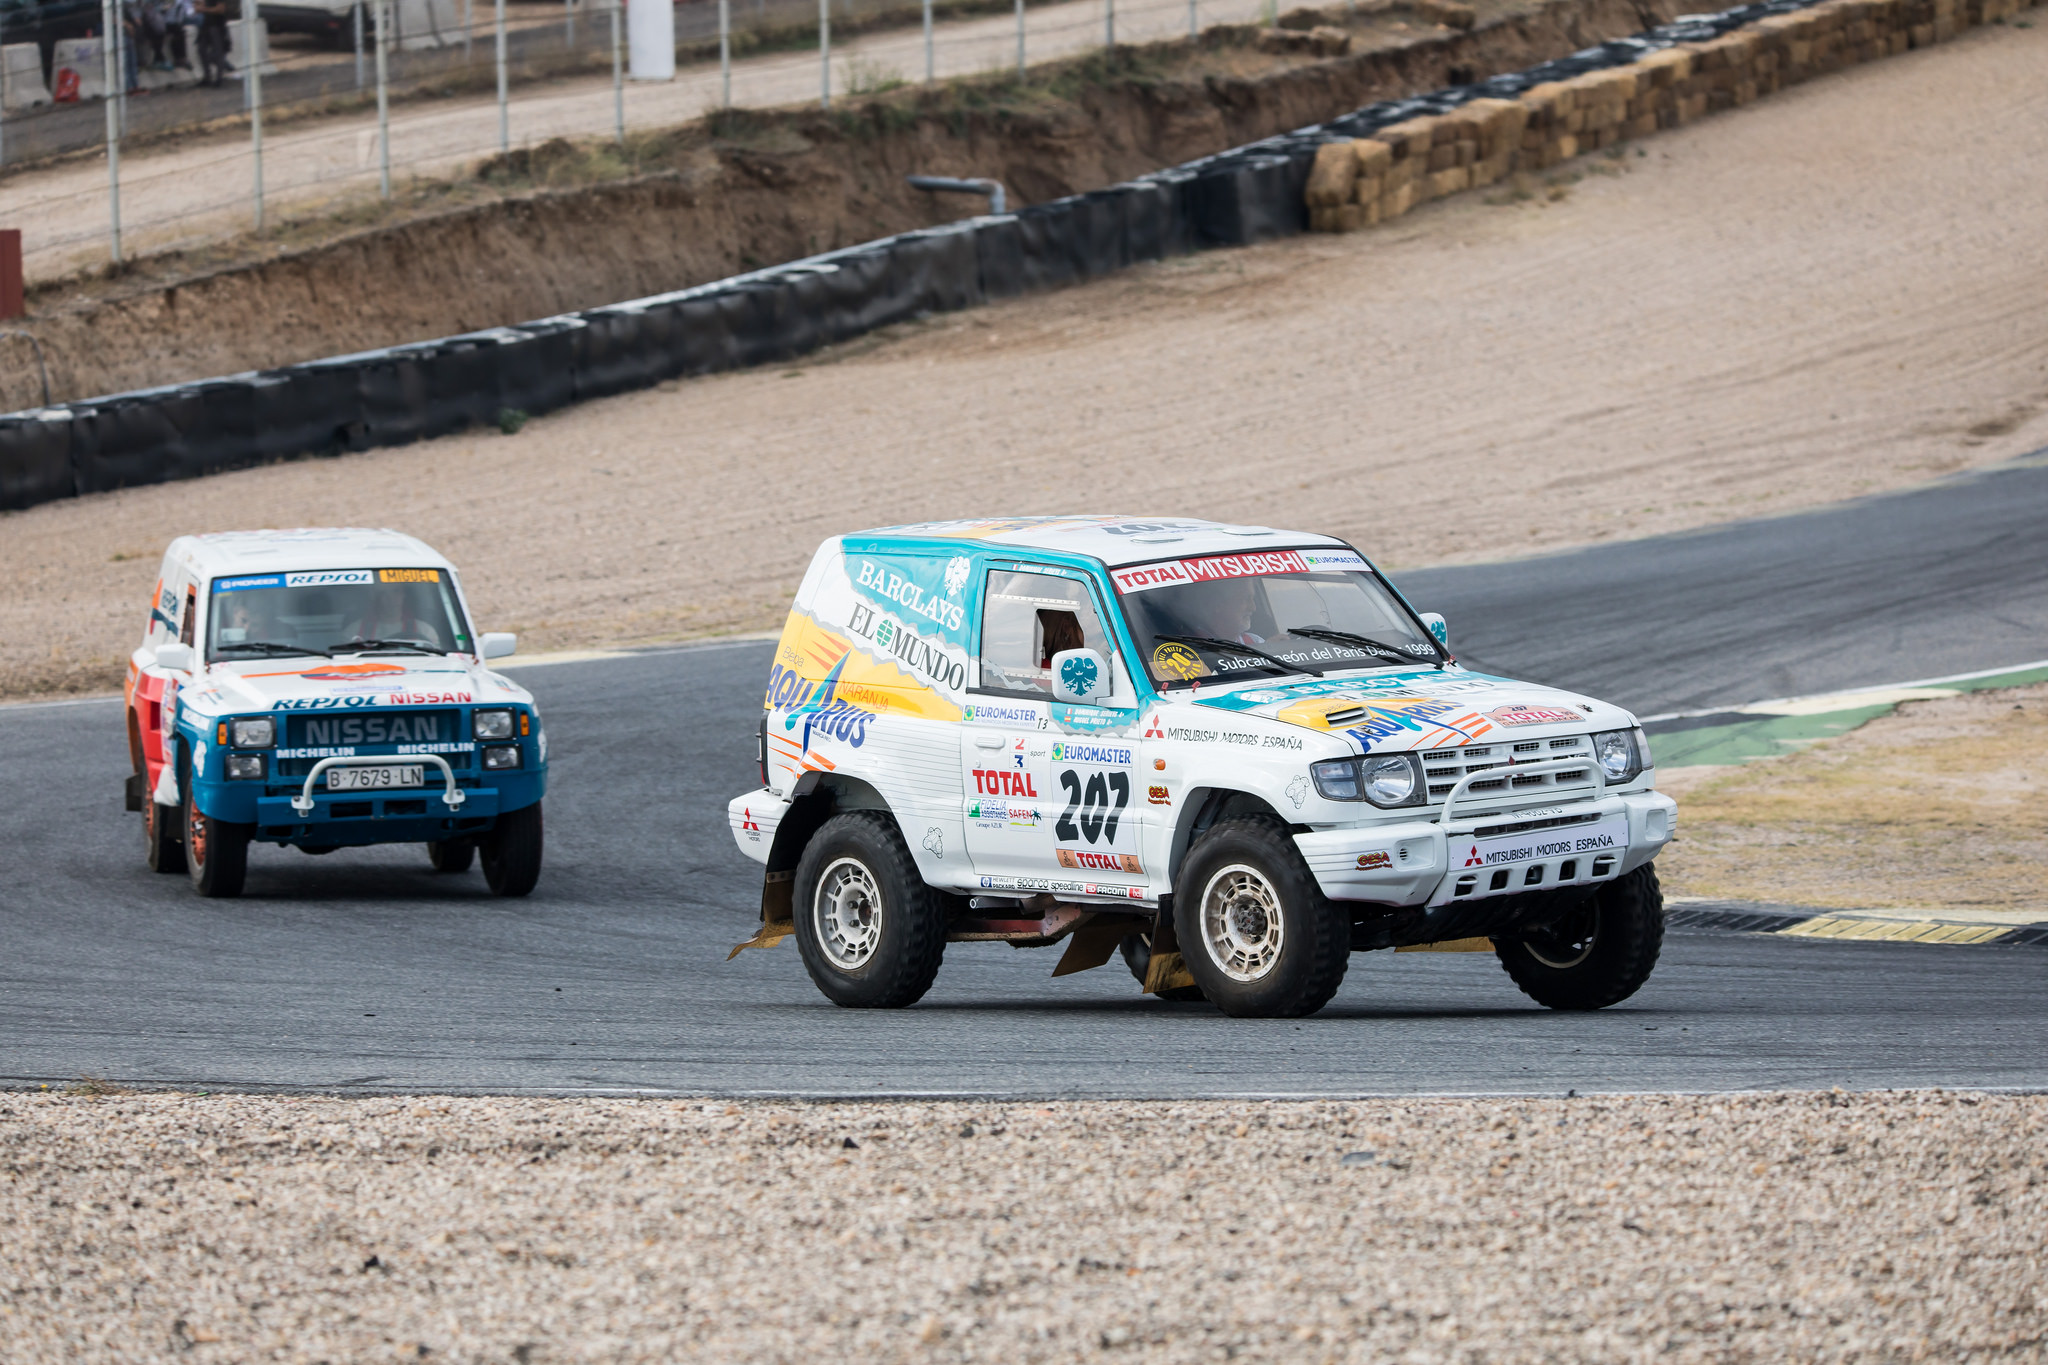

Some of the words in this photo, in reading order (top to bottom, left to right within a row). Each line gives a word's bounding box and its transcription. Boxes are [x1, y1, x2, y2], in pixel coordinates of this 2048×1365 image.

[386, 569, 435, 582] MIGUEL
[1117, 566, 1186, 587] TOTAL
[1184, 552, 1306, 580] MITSUBISHI
[1316, 556, 1362, 564] EUROMASTER
[231, 577, 279, 587] PIONEER
[289, 572, 369, 584] REPSOL
[856, 560, 964, 631] BARCLAYS
[847, 602, 876, 640] EL
[888, 626, 965, 691] MUNDO
[1311, 647, 1331, 660] del
[1333, 645, 1366, 658] Paris
[1405, 643, 1435, 655] 1999
[1166, 652, 1191, 674] 20
[272, 695, 377, 710] REPSOL
[390, 692, 472, 704] NISSAN
[767, 650, 877, 752] AQUARIUS
[838, 679, 889, 710] NARANJA
[975, 706, 1036, 721] EUROMASTER
[1501, 710, 1564, 720] TOTAL
[306, 716, 438, 745] NISSAN
[1346, 700, 1465, 753] AQUARIUS
[1168, 727, 1218, 742] MITSUBISHI
[1219, 732, 1259, 746] MOTORS
[1262, 736, 1303, 751] ESPAÑA
[276, 747, 355, 758] MICHELIN
[397, 742, 475, 754] MICHELIN
[1064, 745, 1131, 764] EUROMASTER
[972, 769, 1038, 798] TOTAL
[1148, 785, 1169, 798] GESA
[981, 799, 1007, 810] FIDELIA
[1055, 769, 1129, 845] 207
[1009, 808, 1032, 819] SAFEN
[1486, 847, 1533, 864] MITSUBISHI
[1536, 841, 1571, 857] MOTORS
[1576, 834, 1614, 851] ESPAÑA
[1076, 852, 1123, 871] TOTAL
[1357, 851, 1390, 866] GESA
[1017, 879, 1049, 890] sparco
[1051, 881, 1084, 892] speedline
[1097, 886, 1127, 896] FACOM
